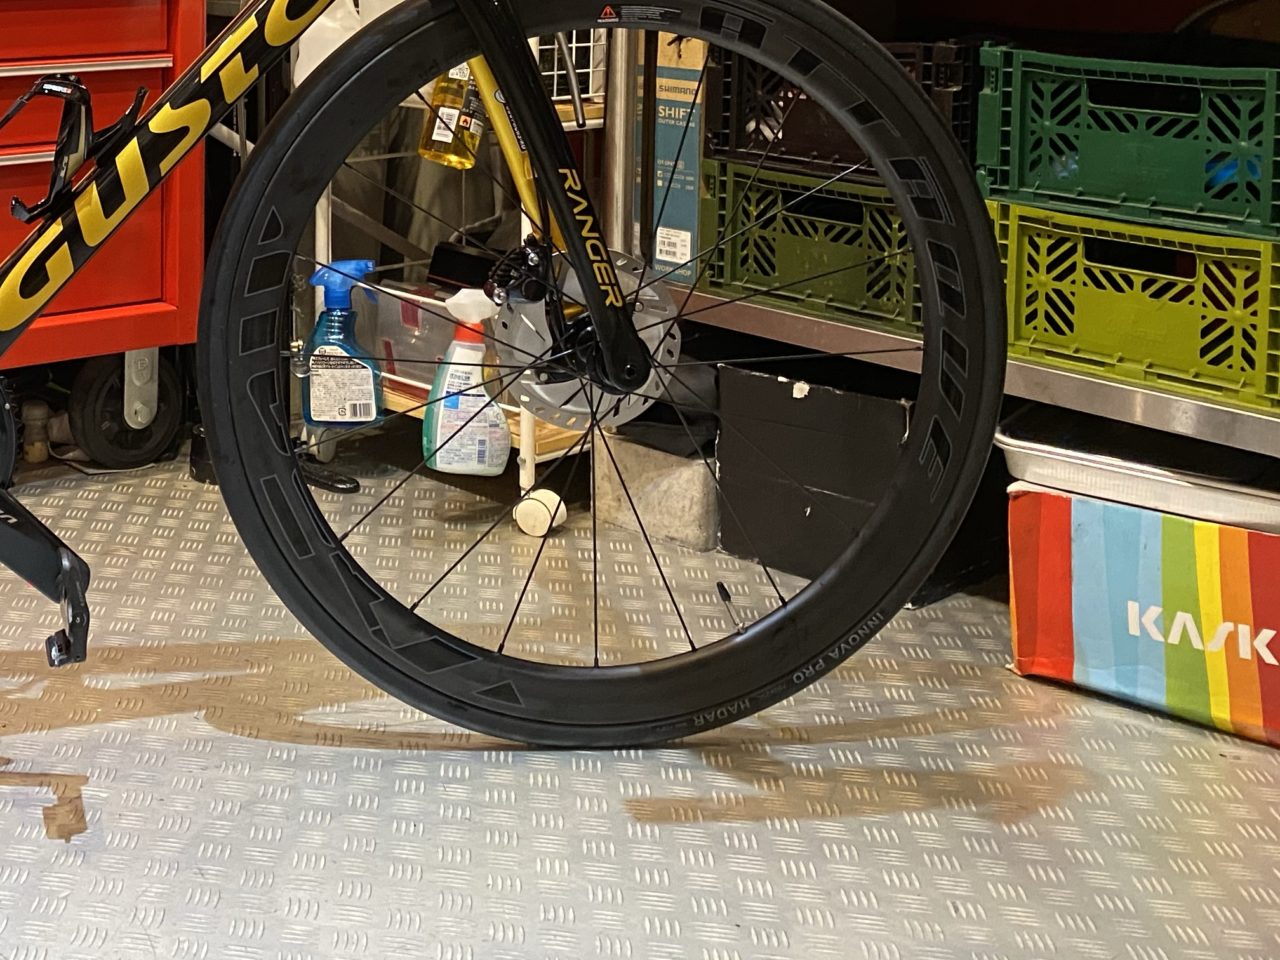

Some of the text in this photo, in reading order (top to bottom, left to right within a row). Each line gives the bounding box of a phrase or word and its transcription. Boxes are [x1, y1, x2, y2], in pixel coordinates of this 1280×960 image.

[558, 168, 624, 307] RANGER
[792, 611, 885, 685] INNOVA PRO
[1127, 600, 1279, 666] KASK
[691, 698, 751, 727] HADAR
